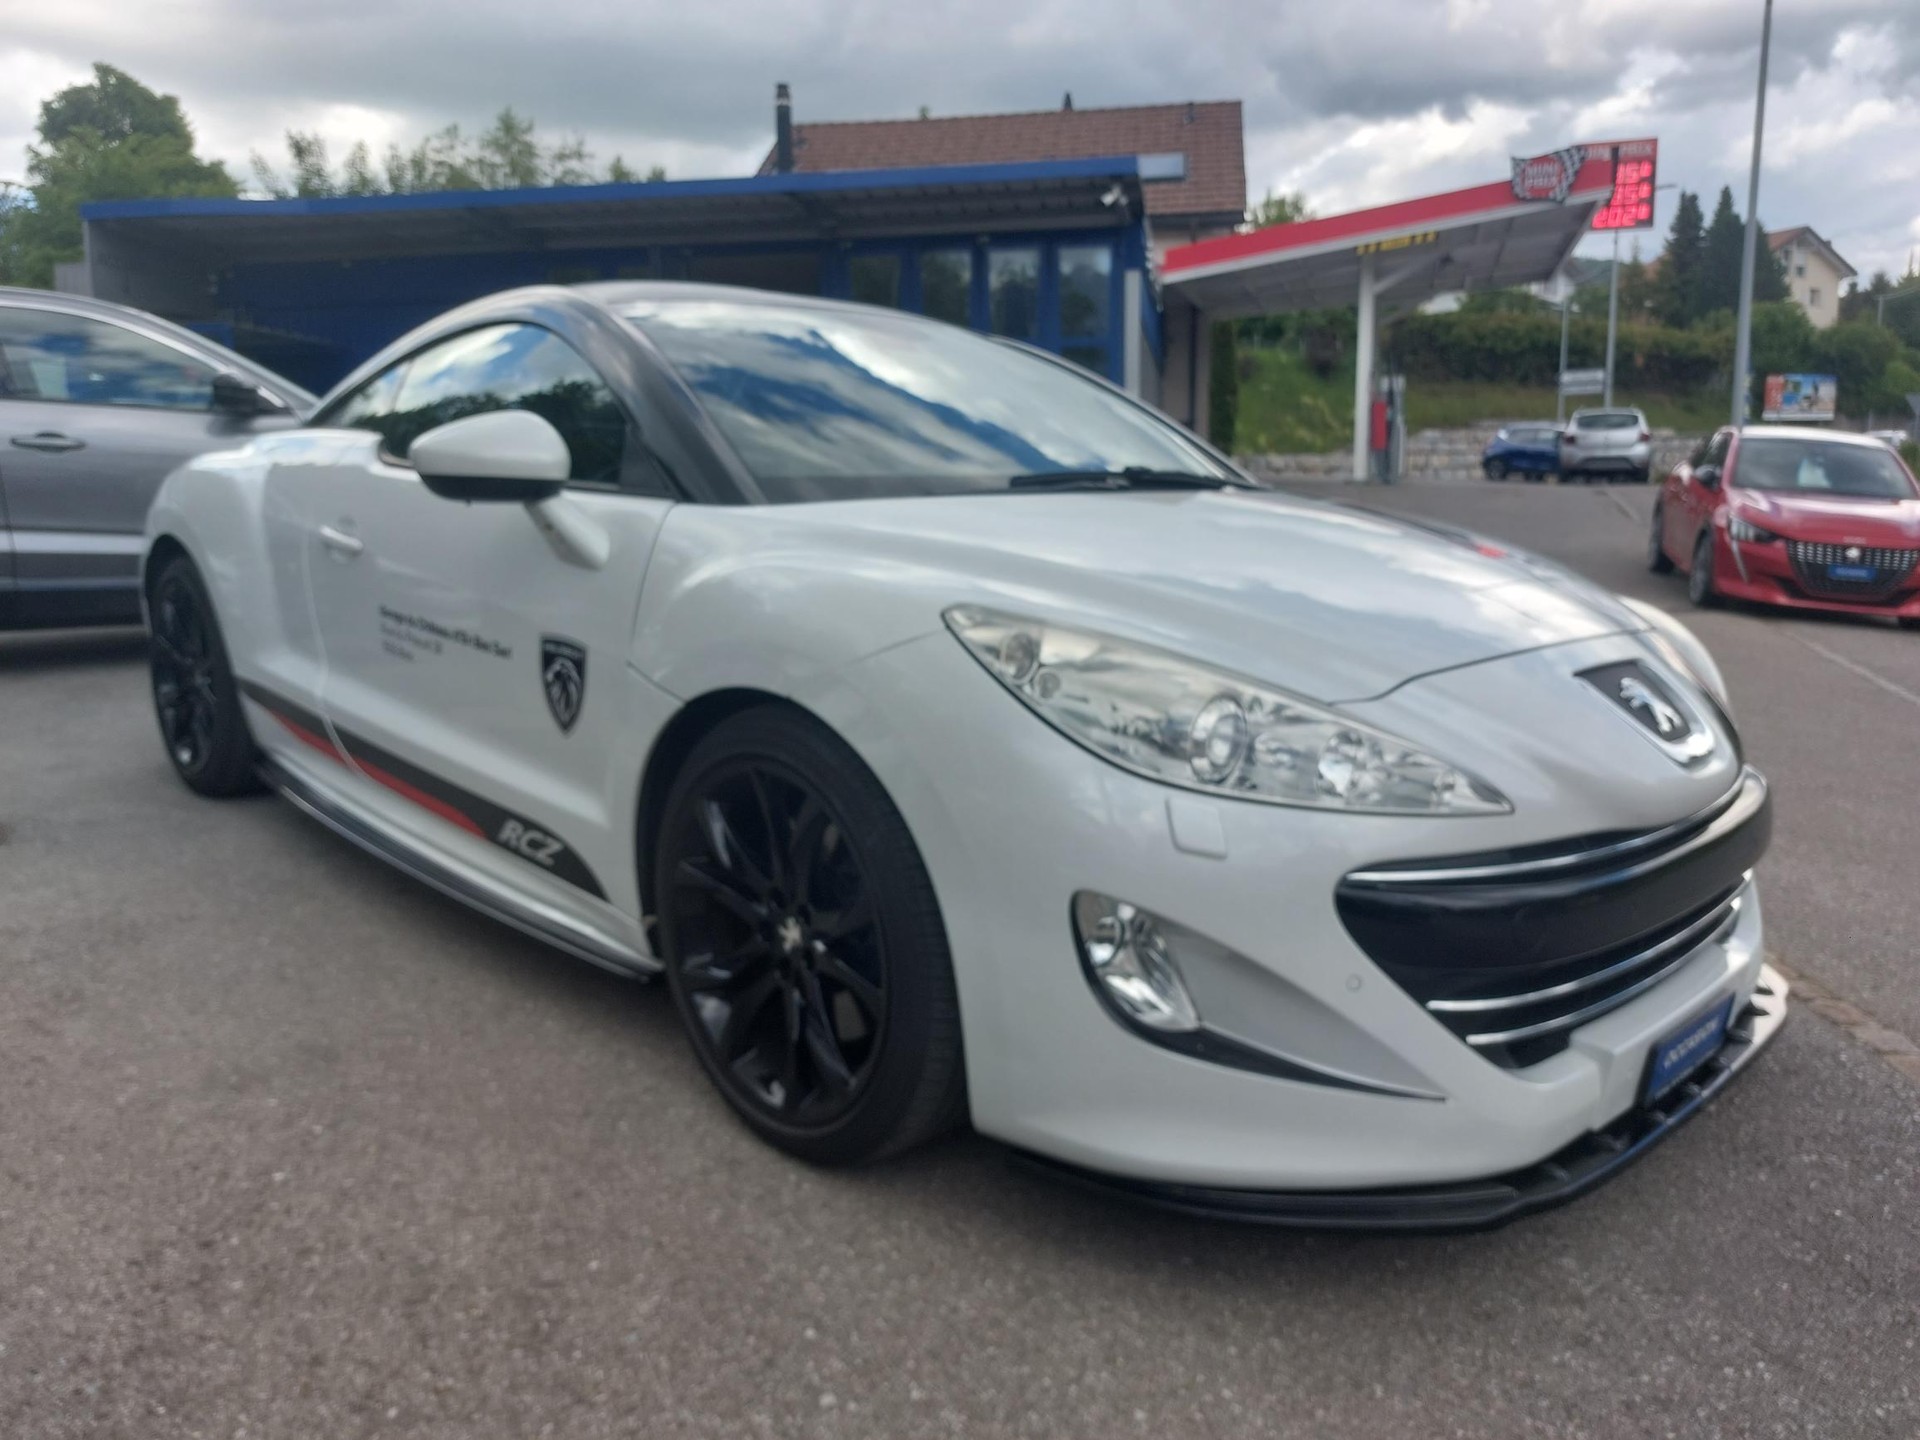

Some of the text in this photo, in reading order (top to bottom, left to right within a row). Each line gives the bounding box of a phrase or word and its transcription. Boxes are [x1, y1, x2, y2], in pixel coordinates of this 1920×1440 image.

[1524, 161, 1557, 177] MINI
[1525, 174, 1557, 188] PRIX
[498, 818, 563, 866] RCZ
